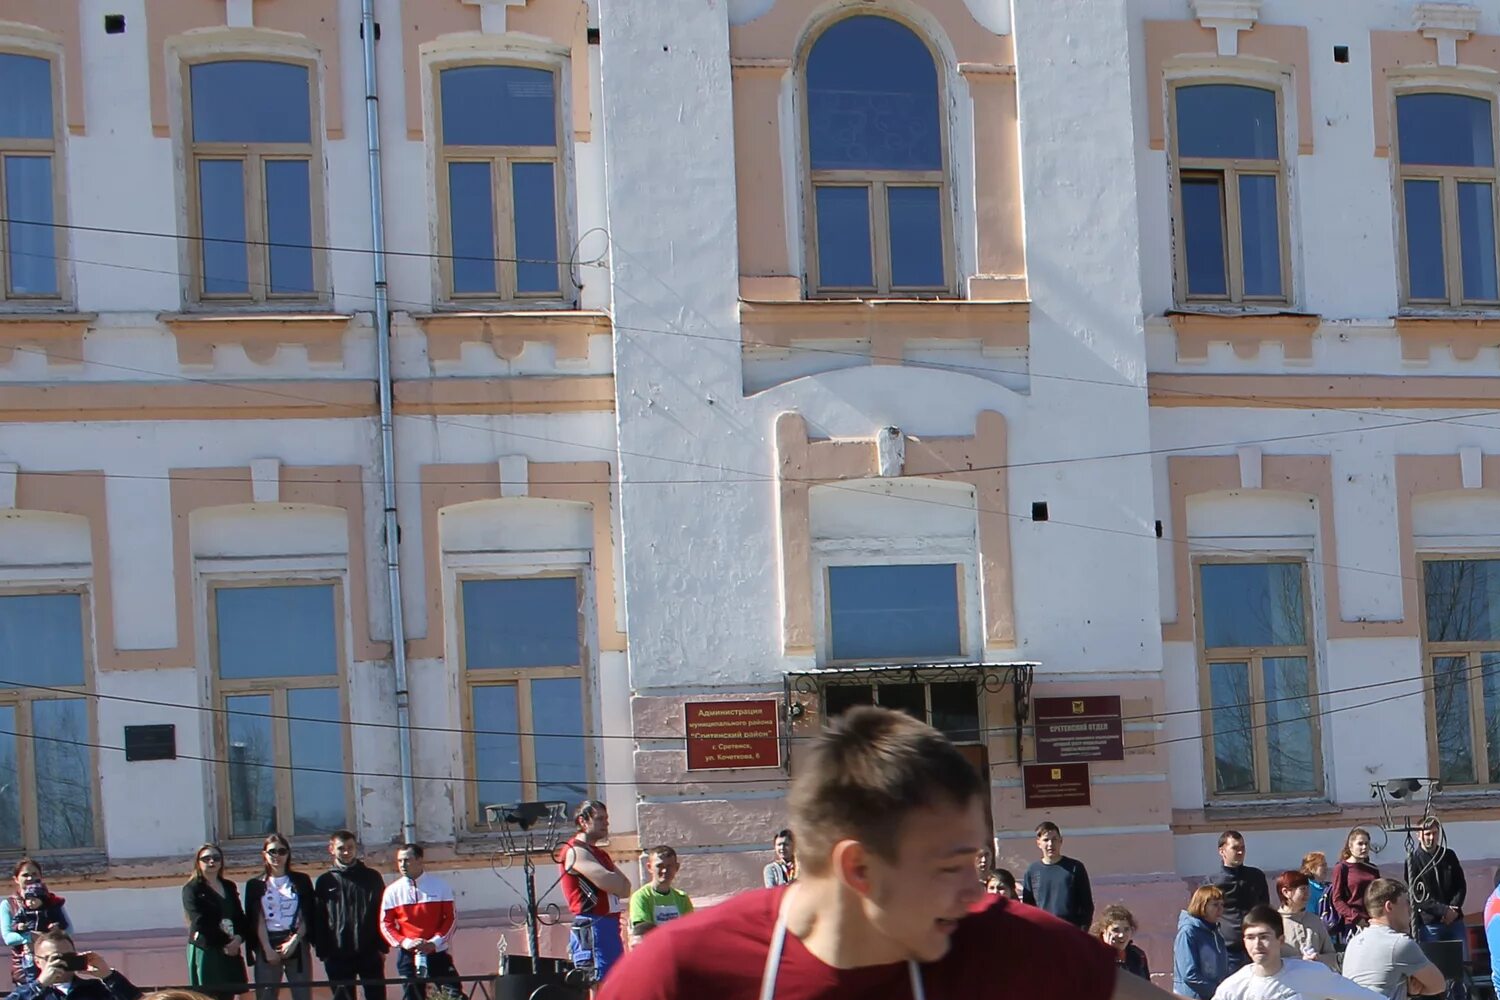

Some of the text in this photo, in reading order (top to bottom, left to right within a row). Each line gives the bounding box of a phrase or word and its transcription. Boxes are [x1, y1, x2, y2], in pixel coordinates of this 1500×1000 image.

[698, 708, 762, 717] Администрация
[689, 719, 773, 729] муниципального района
